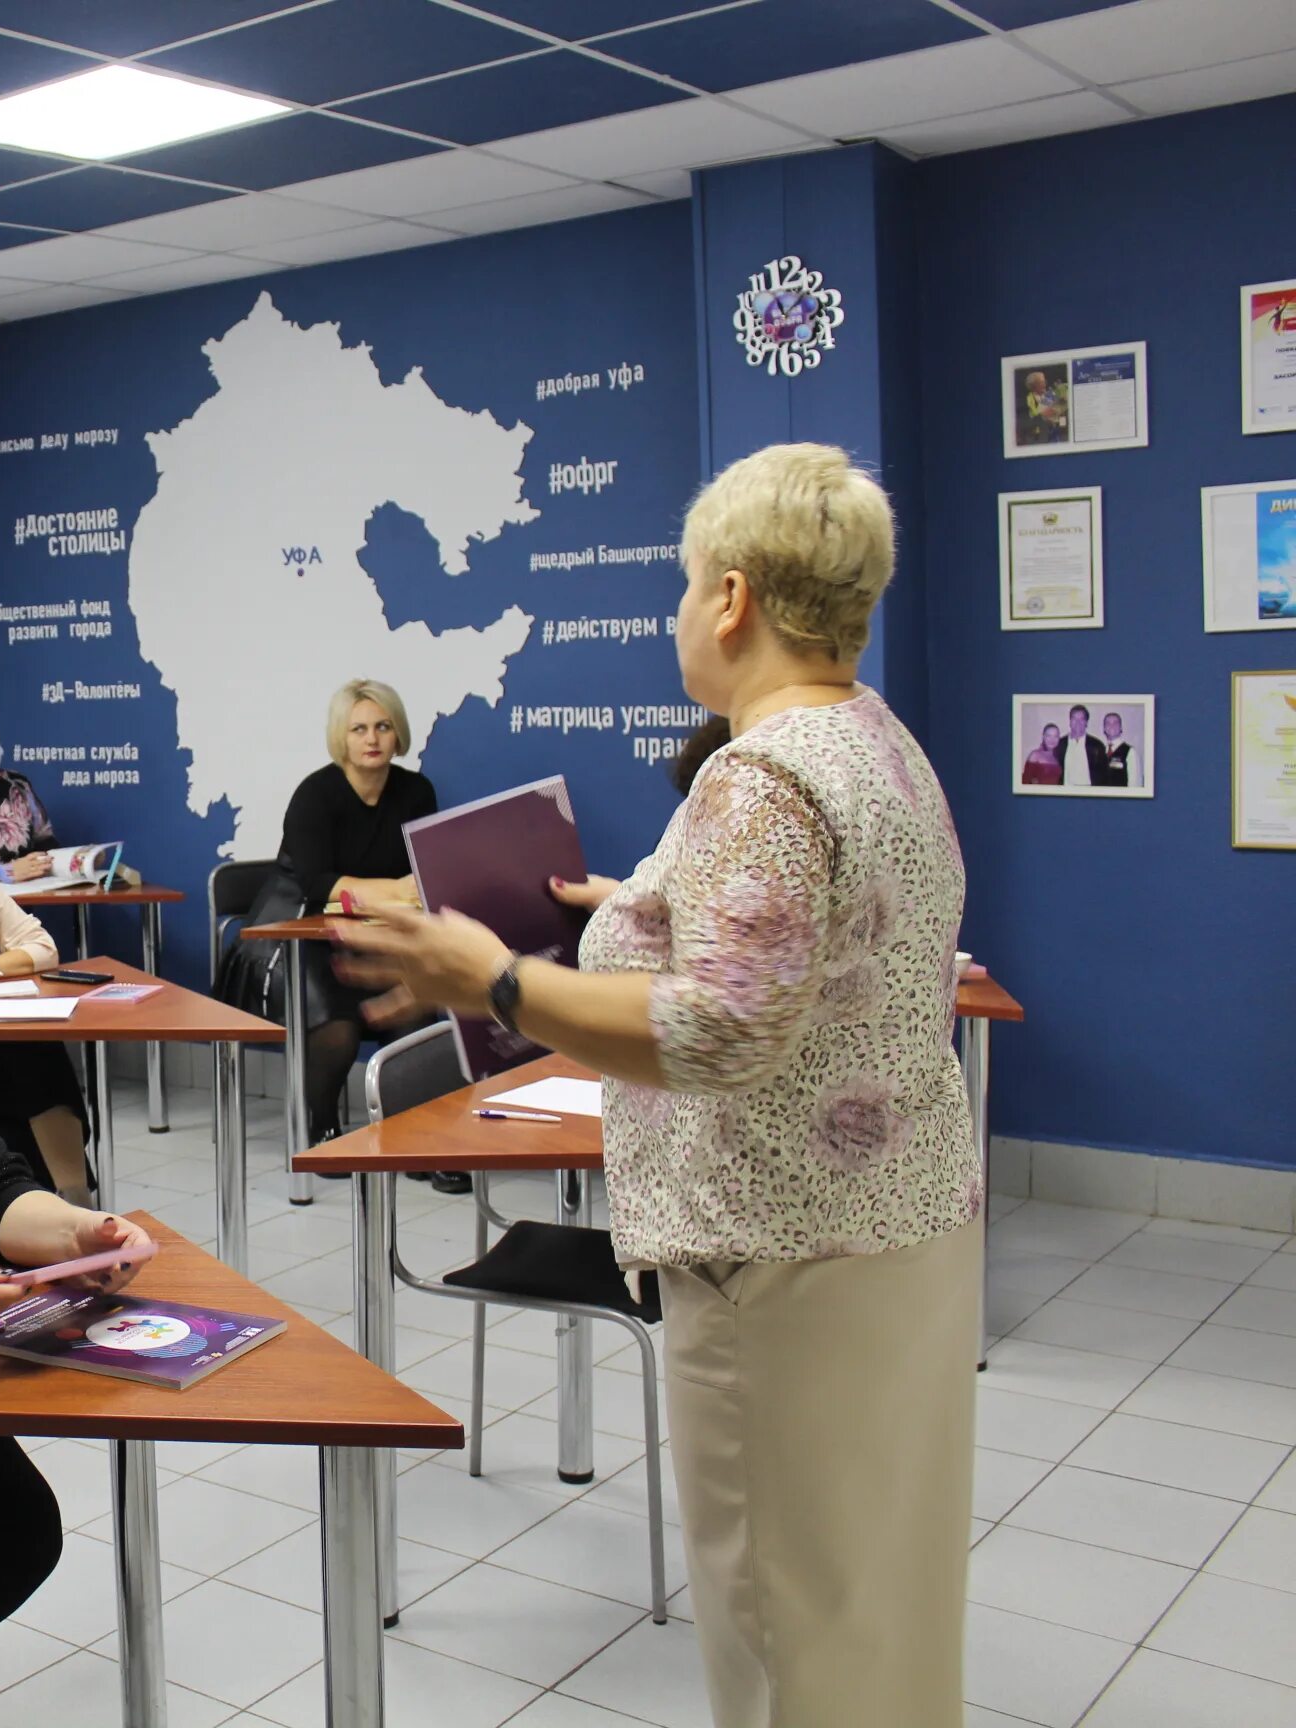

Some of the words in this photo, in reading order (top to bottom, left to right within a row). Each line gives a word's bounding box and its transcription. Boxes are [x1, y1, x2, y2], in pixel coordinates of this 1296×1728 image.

[748, 272, 766, 292] 11
[763, 255, 802, 291] 12
[811, 288, 844, 328] 3
[733, 308, 755, 344] 9
[745, 336, 764, 366] 8
[761, 342, 780, 376] 7
[779, 340, 803, 377] 6
[802, 342, 821, 368] 5
[536, 372, 600, 401] #добрая
[607, 361, 644, 391] уфа
[74, 428, 119, 447] морозу
[548, 456, 618, 494] #офрг
[1270, 498, 1296, 513] ДИ
[281, 545, 323, 566] УФА
[530, 548, 594, 572] #щедрый
[80, 599, 111, 618] фонд
[69, 621, 112, 641] города
[542, 615, 658, 645] #действуем
[666, 615, 677, 636] в
[510, 705, 614, 735] #матрица
[13, 744, 86, 765] #секретная
[90, 742, 139, 765] служба
[634, 736, 690, 766] прак
[62, 770, 90, 787] деда
[94, 769, 140, 789] мороза
